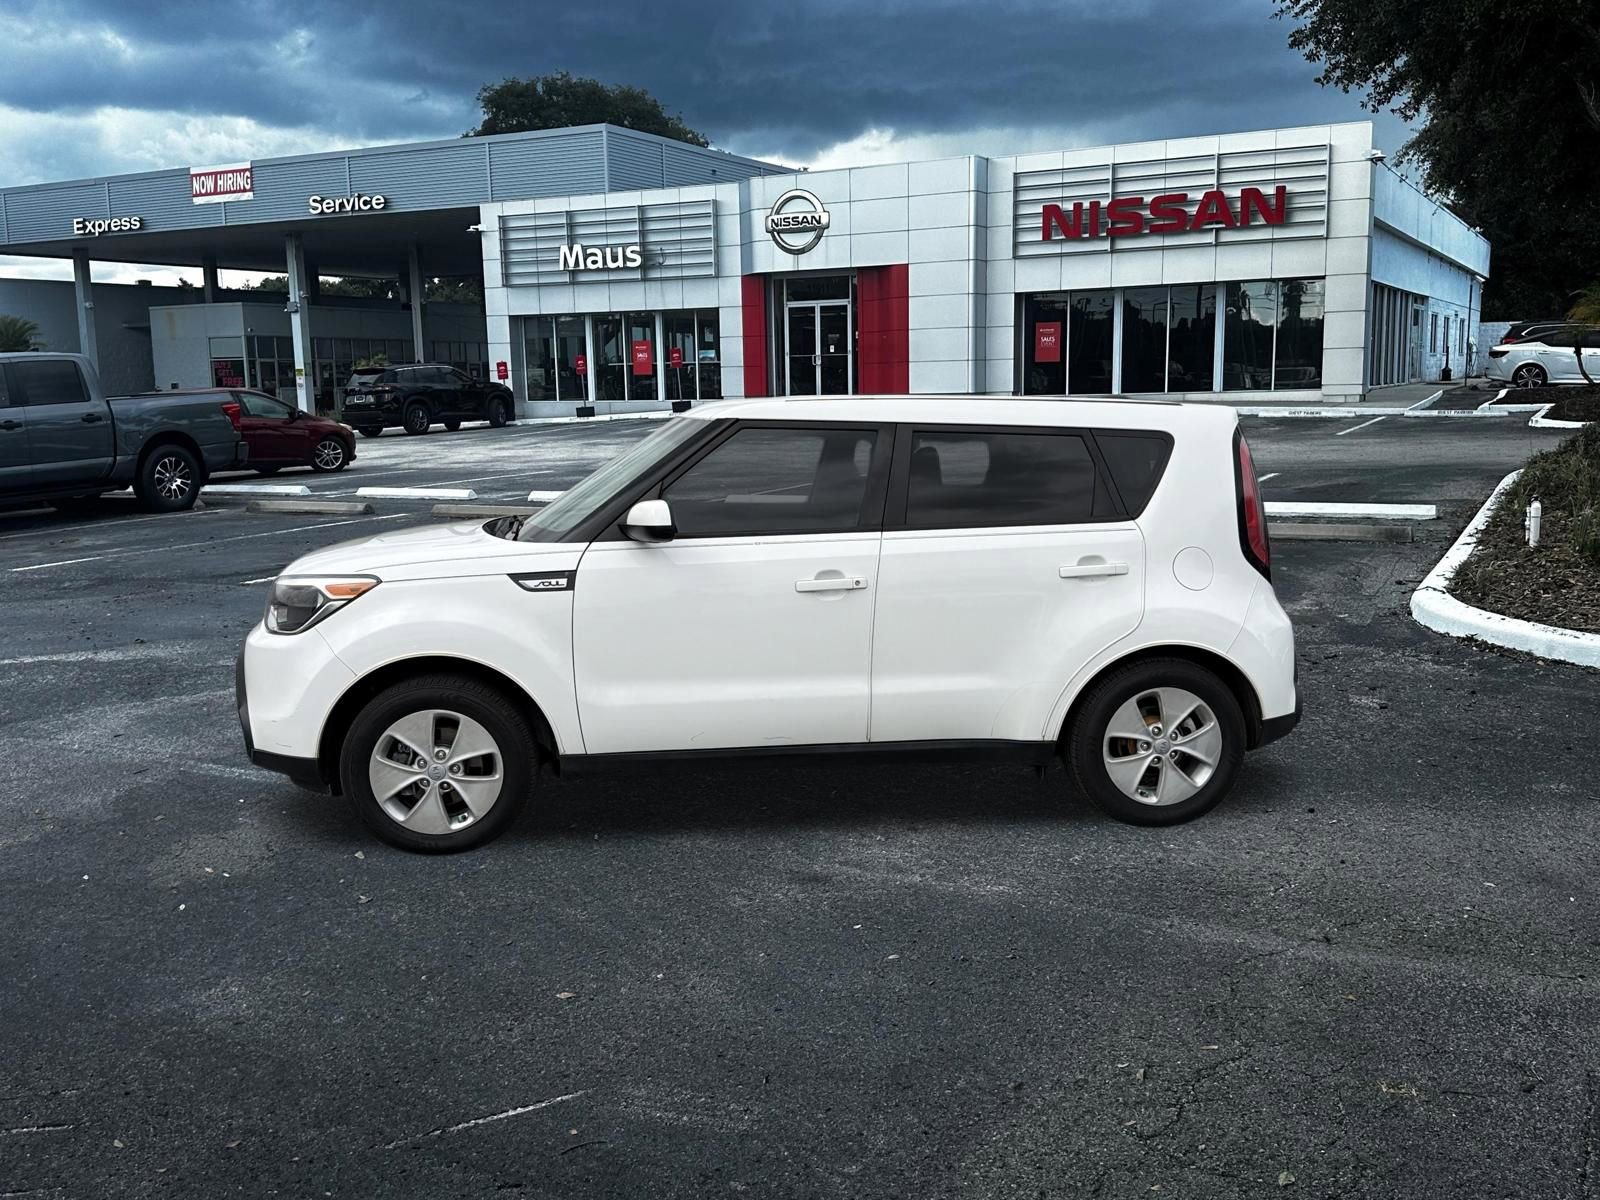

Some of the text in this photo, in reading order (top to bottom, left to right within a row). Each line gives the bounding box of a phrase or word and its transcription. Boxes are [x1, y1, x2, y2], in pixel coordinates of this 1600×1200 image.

[192, 171, 251, 194] NOW HIRING
[308, 193, 385, 214] Service
[1041, 185, 1287, 241] NISSAN
[73, 216, 141, 236] Express
[770, 215, 822, 228] NISSAN
[559, 243, 642, 271] Maus
[534, 580, 565, 588] SOUL
